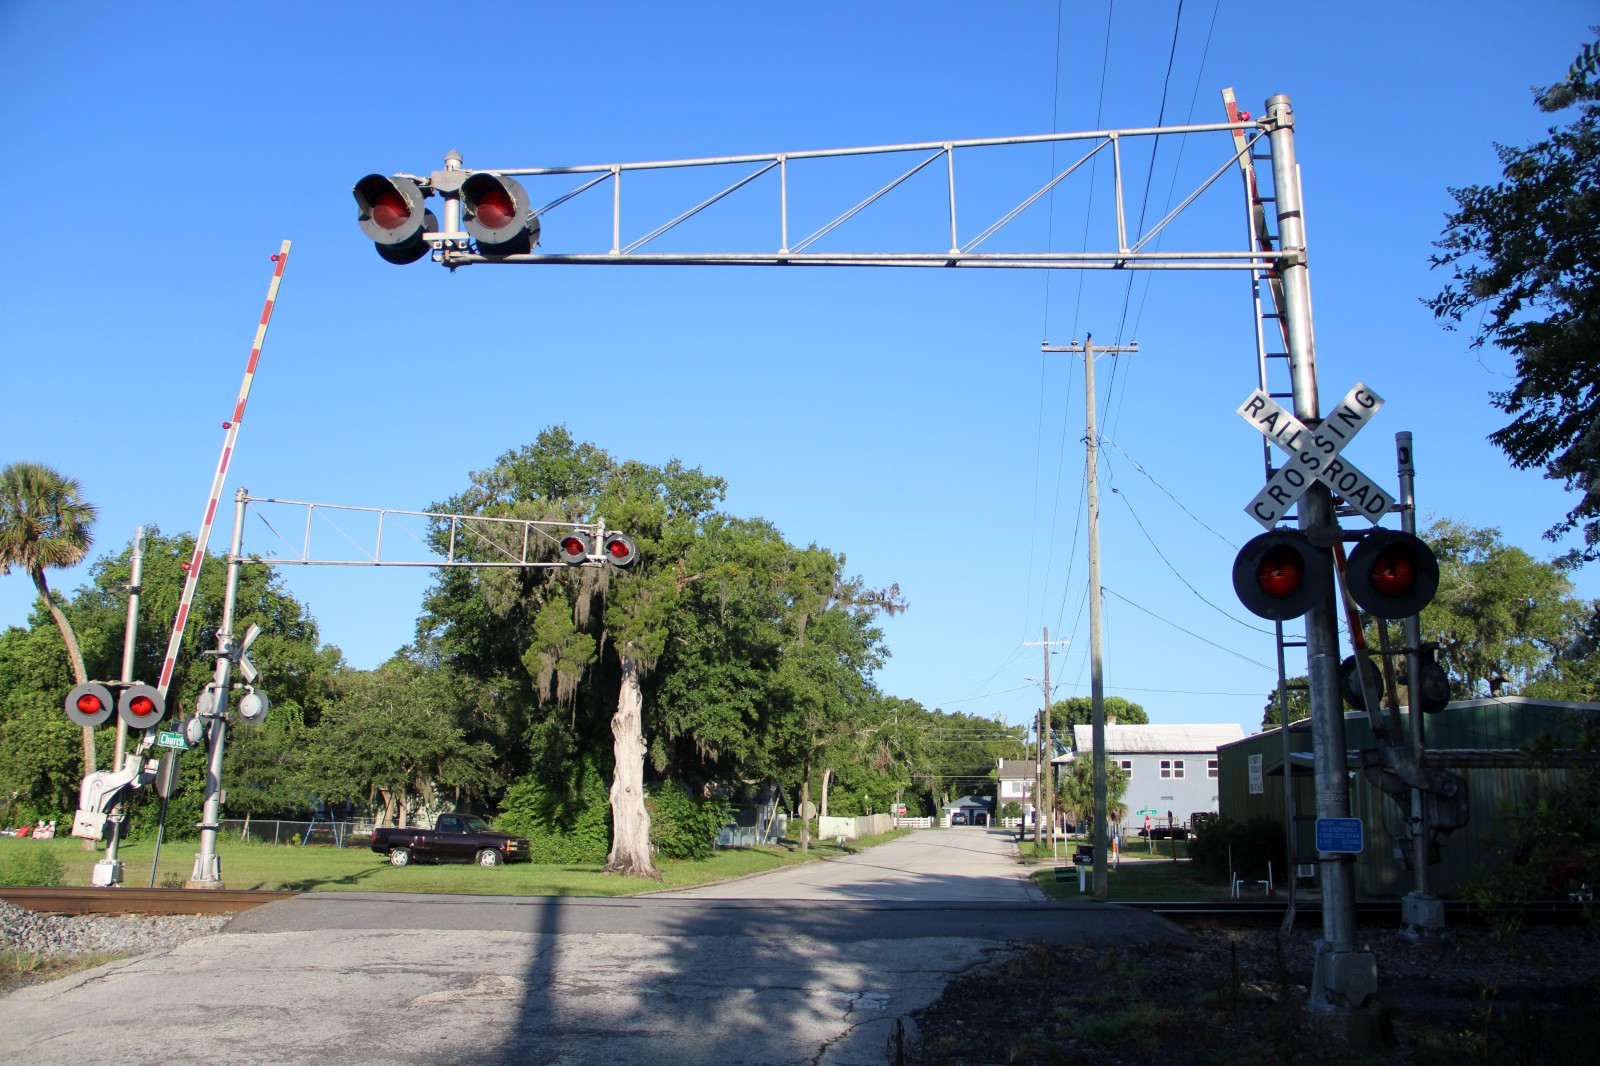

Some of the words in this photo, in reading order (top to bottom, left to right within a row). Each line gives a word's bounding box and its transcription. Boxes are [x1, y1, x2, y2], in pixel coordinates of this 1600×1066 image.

[1243, 395, 1302, 452] RAIL
[1321, 458, 1386, 515] ROAD
[1253, 389, 1376, 522] CROSSING
[160, 734, 185, 746] Church
